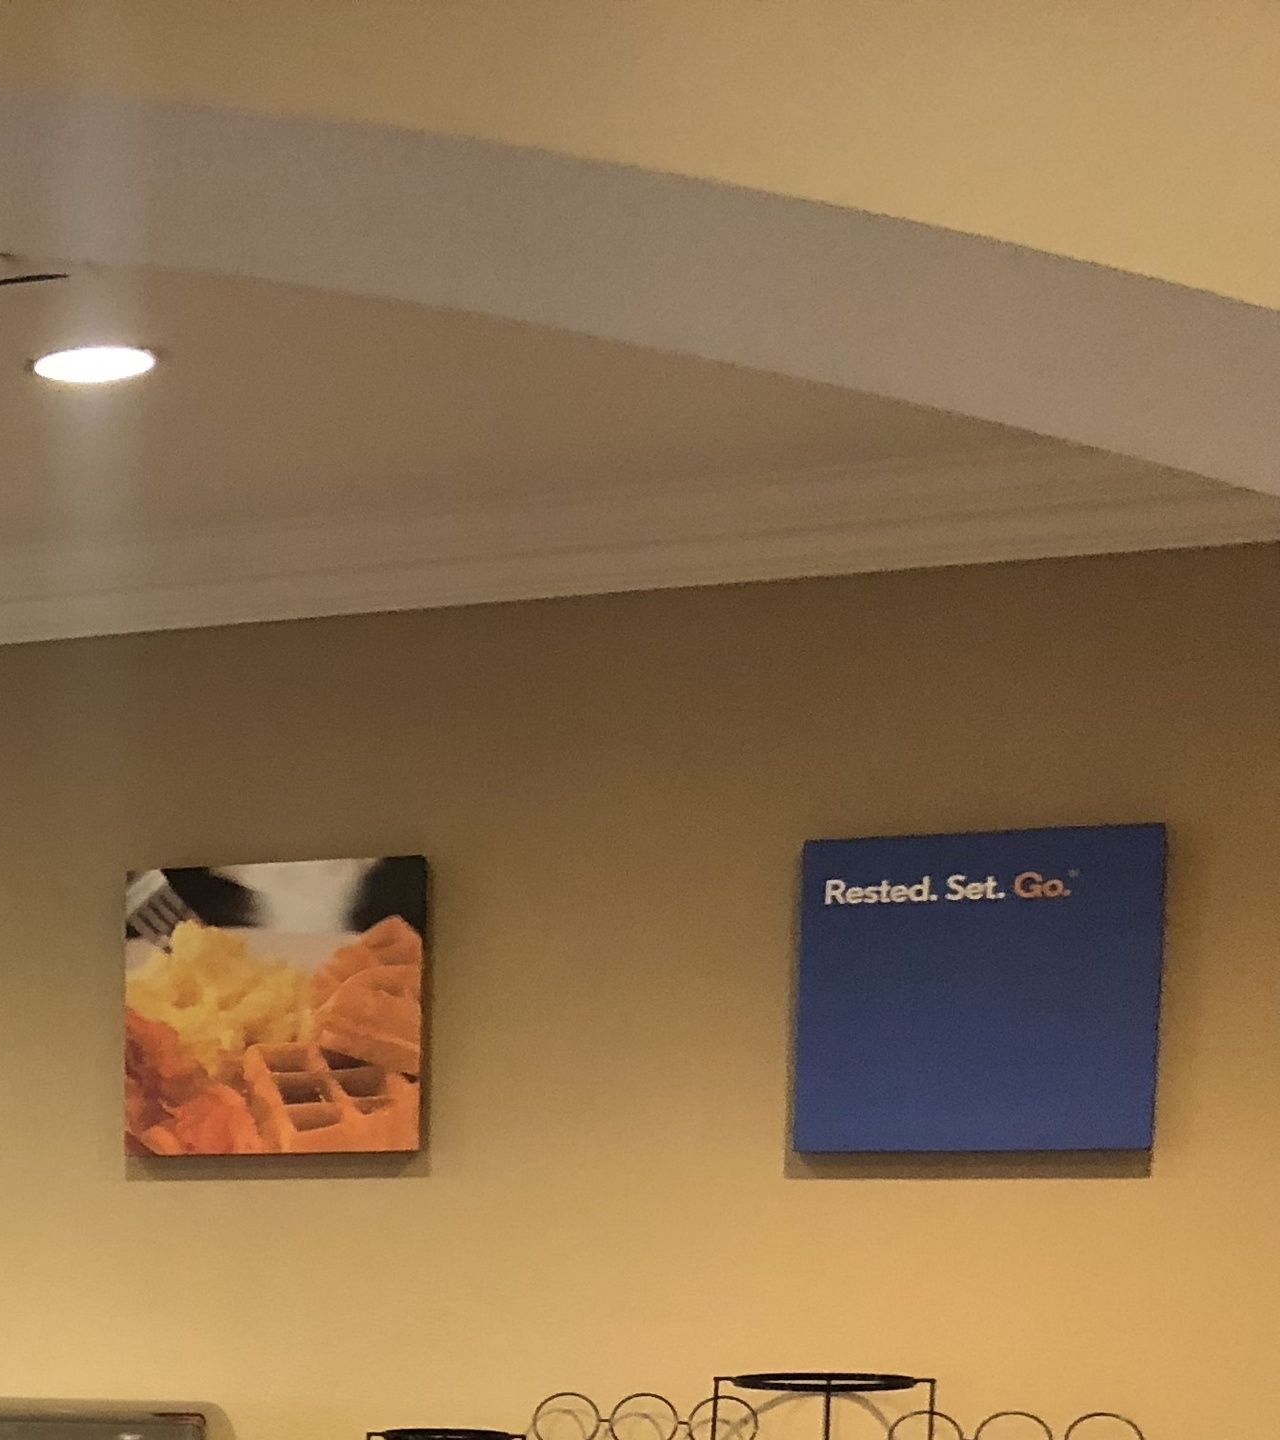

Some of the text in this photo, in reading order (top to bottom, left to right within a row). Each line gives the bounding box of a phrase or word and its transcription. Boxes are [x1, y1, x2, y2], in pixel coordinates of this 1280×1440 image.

[824, 871, 1072, 905] Rested. Set. Go.
